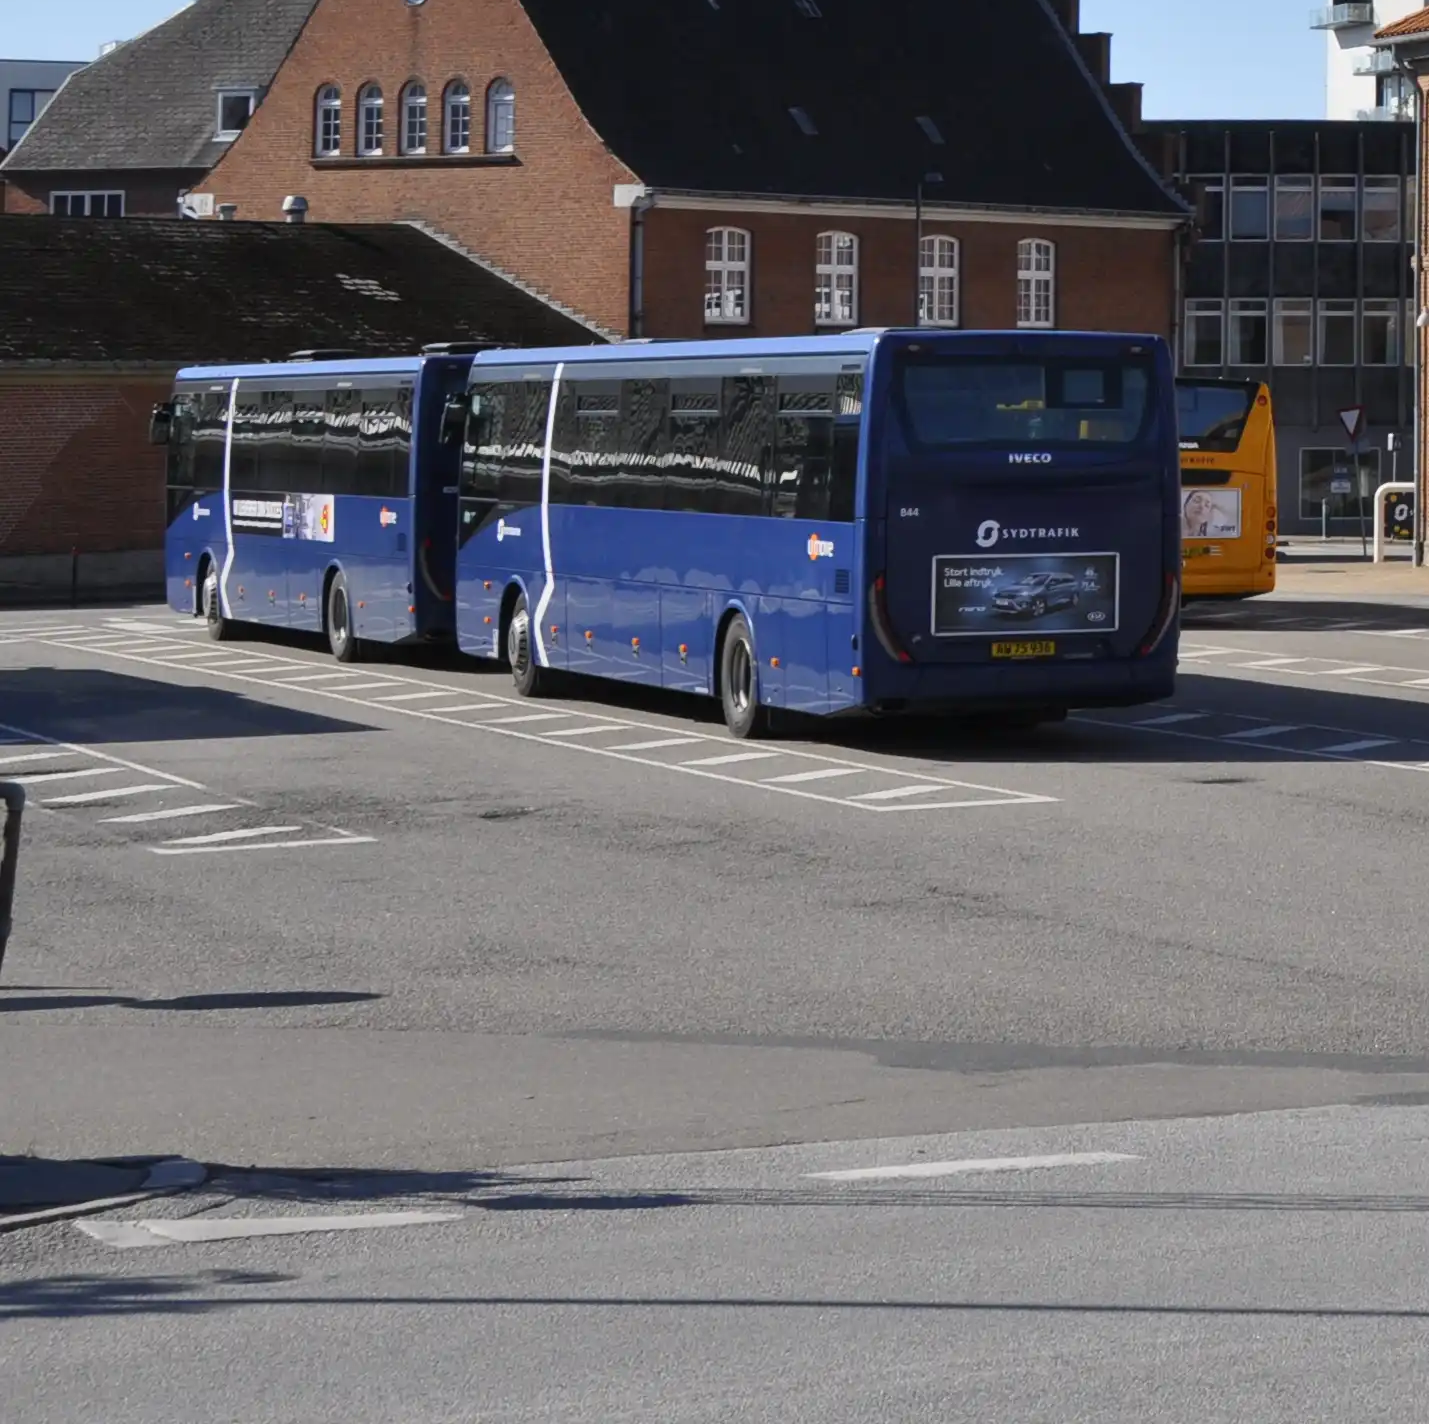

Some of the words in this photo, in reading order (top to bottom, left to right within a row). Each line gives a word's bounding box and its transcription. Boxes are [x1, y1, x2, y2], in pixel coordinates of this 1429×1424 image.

[1008, 453, 1052, 463] IVECO
[1002, 528, 1079, 539] SYDTRAFIK
[944, 567, 968, 577] Stort
